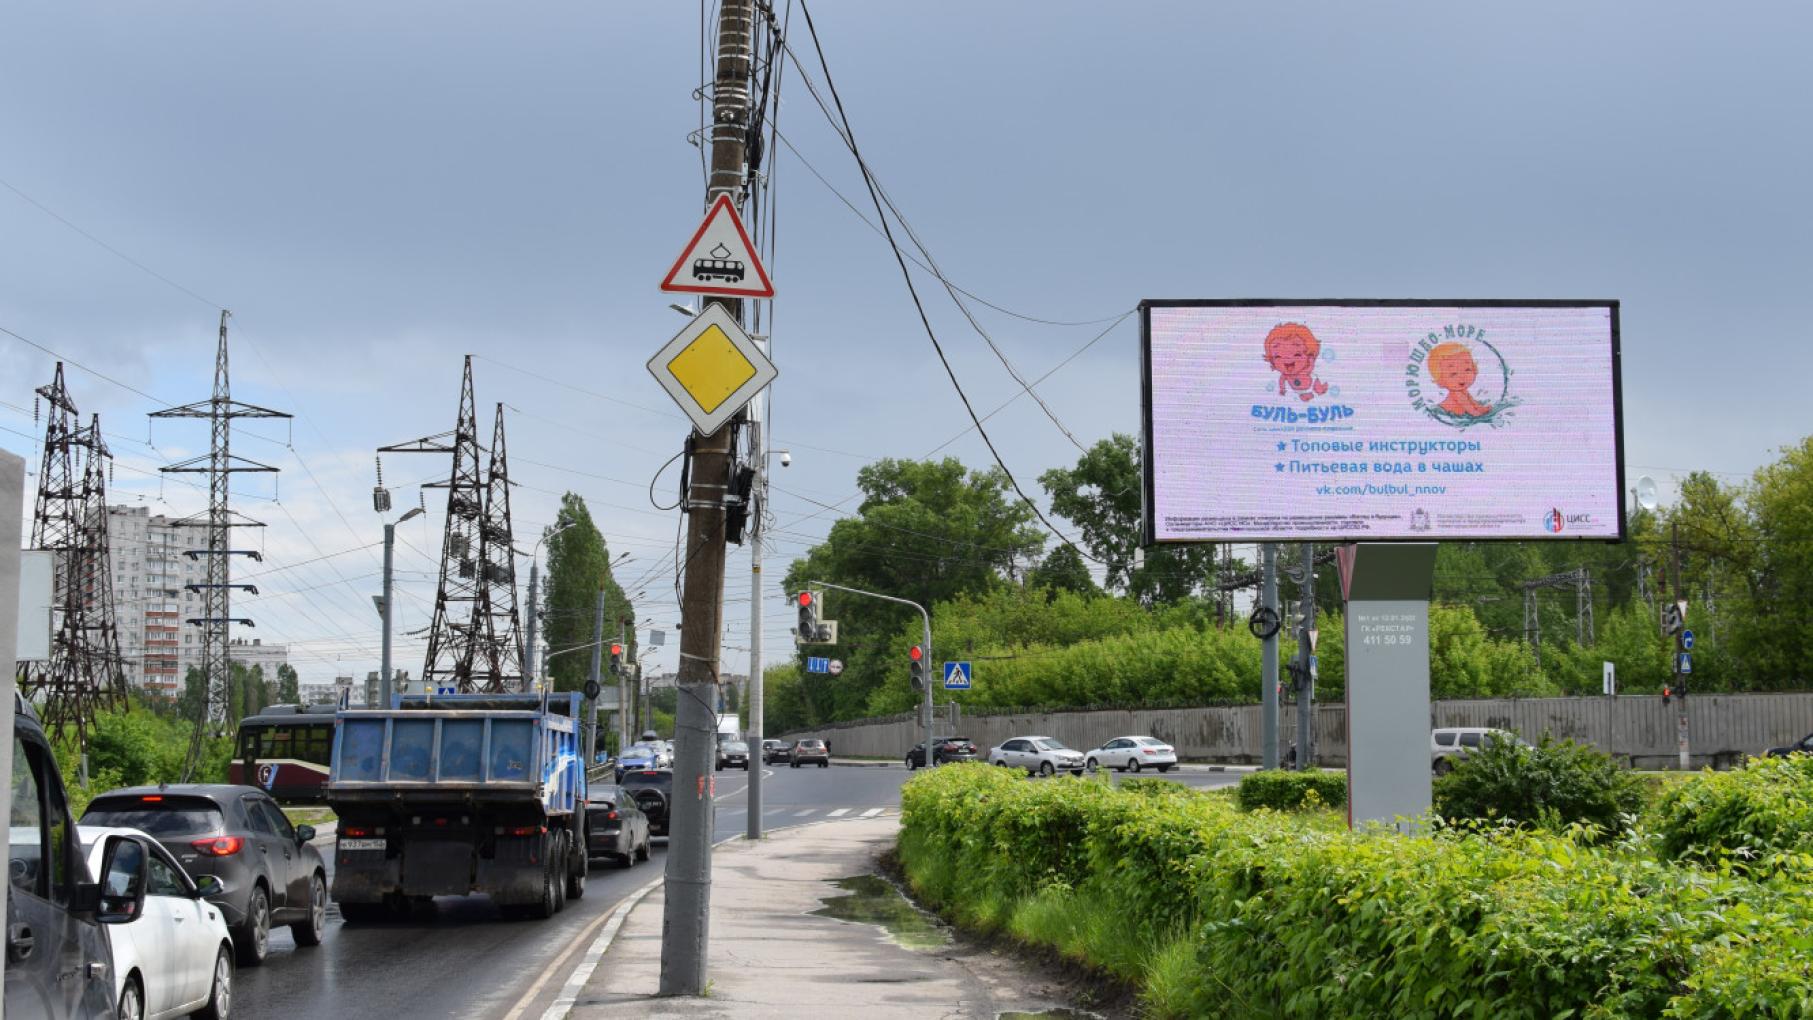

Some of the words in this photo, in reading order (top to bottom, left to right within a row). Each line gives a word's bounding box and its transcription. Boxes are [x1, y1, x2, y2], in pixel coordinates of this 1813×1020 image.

[1251, 404, 1354, 423] БУЛЬ-БУЛЬ
[1292, 439, 1364, 452] Топовые
[1369, 440, 1481, 455] инструкторы
[1289, 460, 1368, 473] Питьевая
[1373, 462, 1412, 474] вода
[1418, 462, 1427, 473] в
[1432, 462, 1484, 473] чашах
[1316, 484, 1446, 497] vk.com/bulbul_nnov
[1363, 635, 1380, 645] 411
[1383, 635, 1396, 645] 50
[1399, 635, 1412, 645] 59
